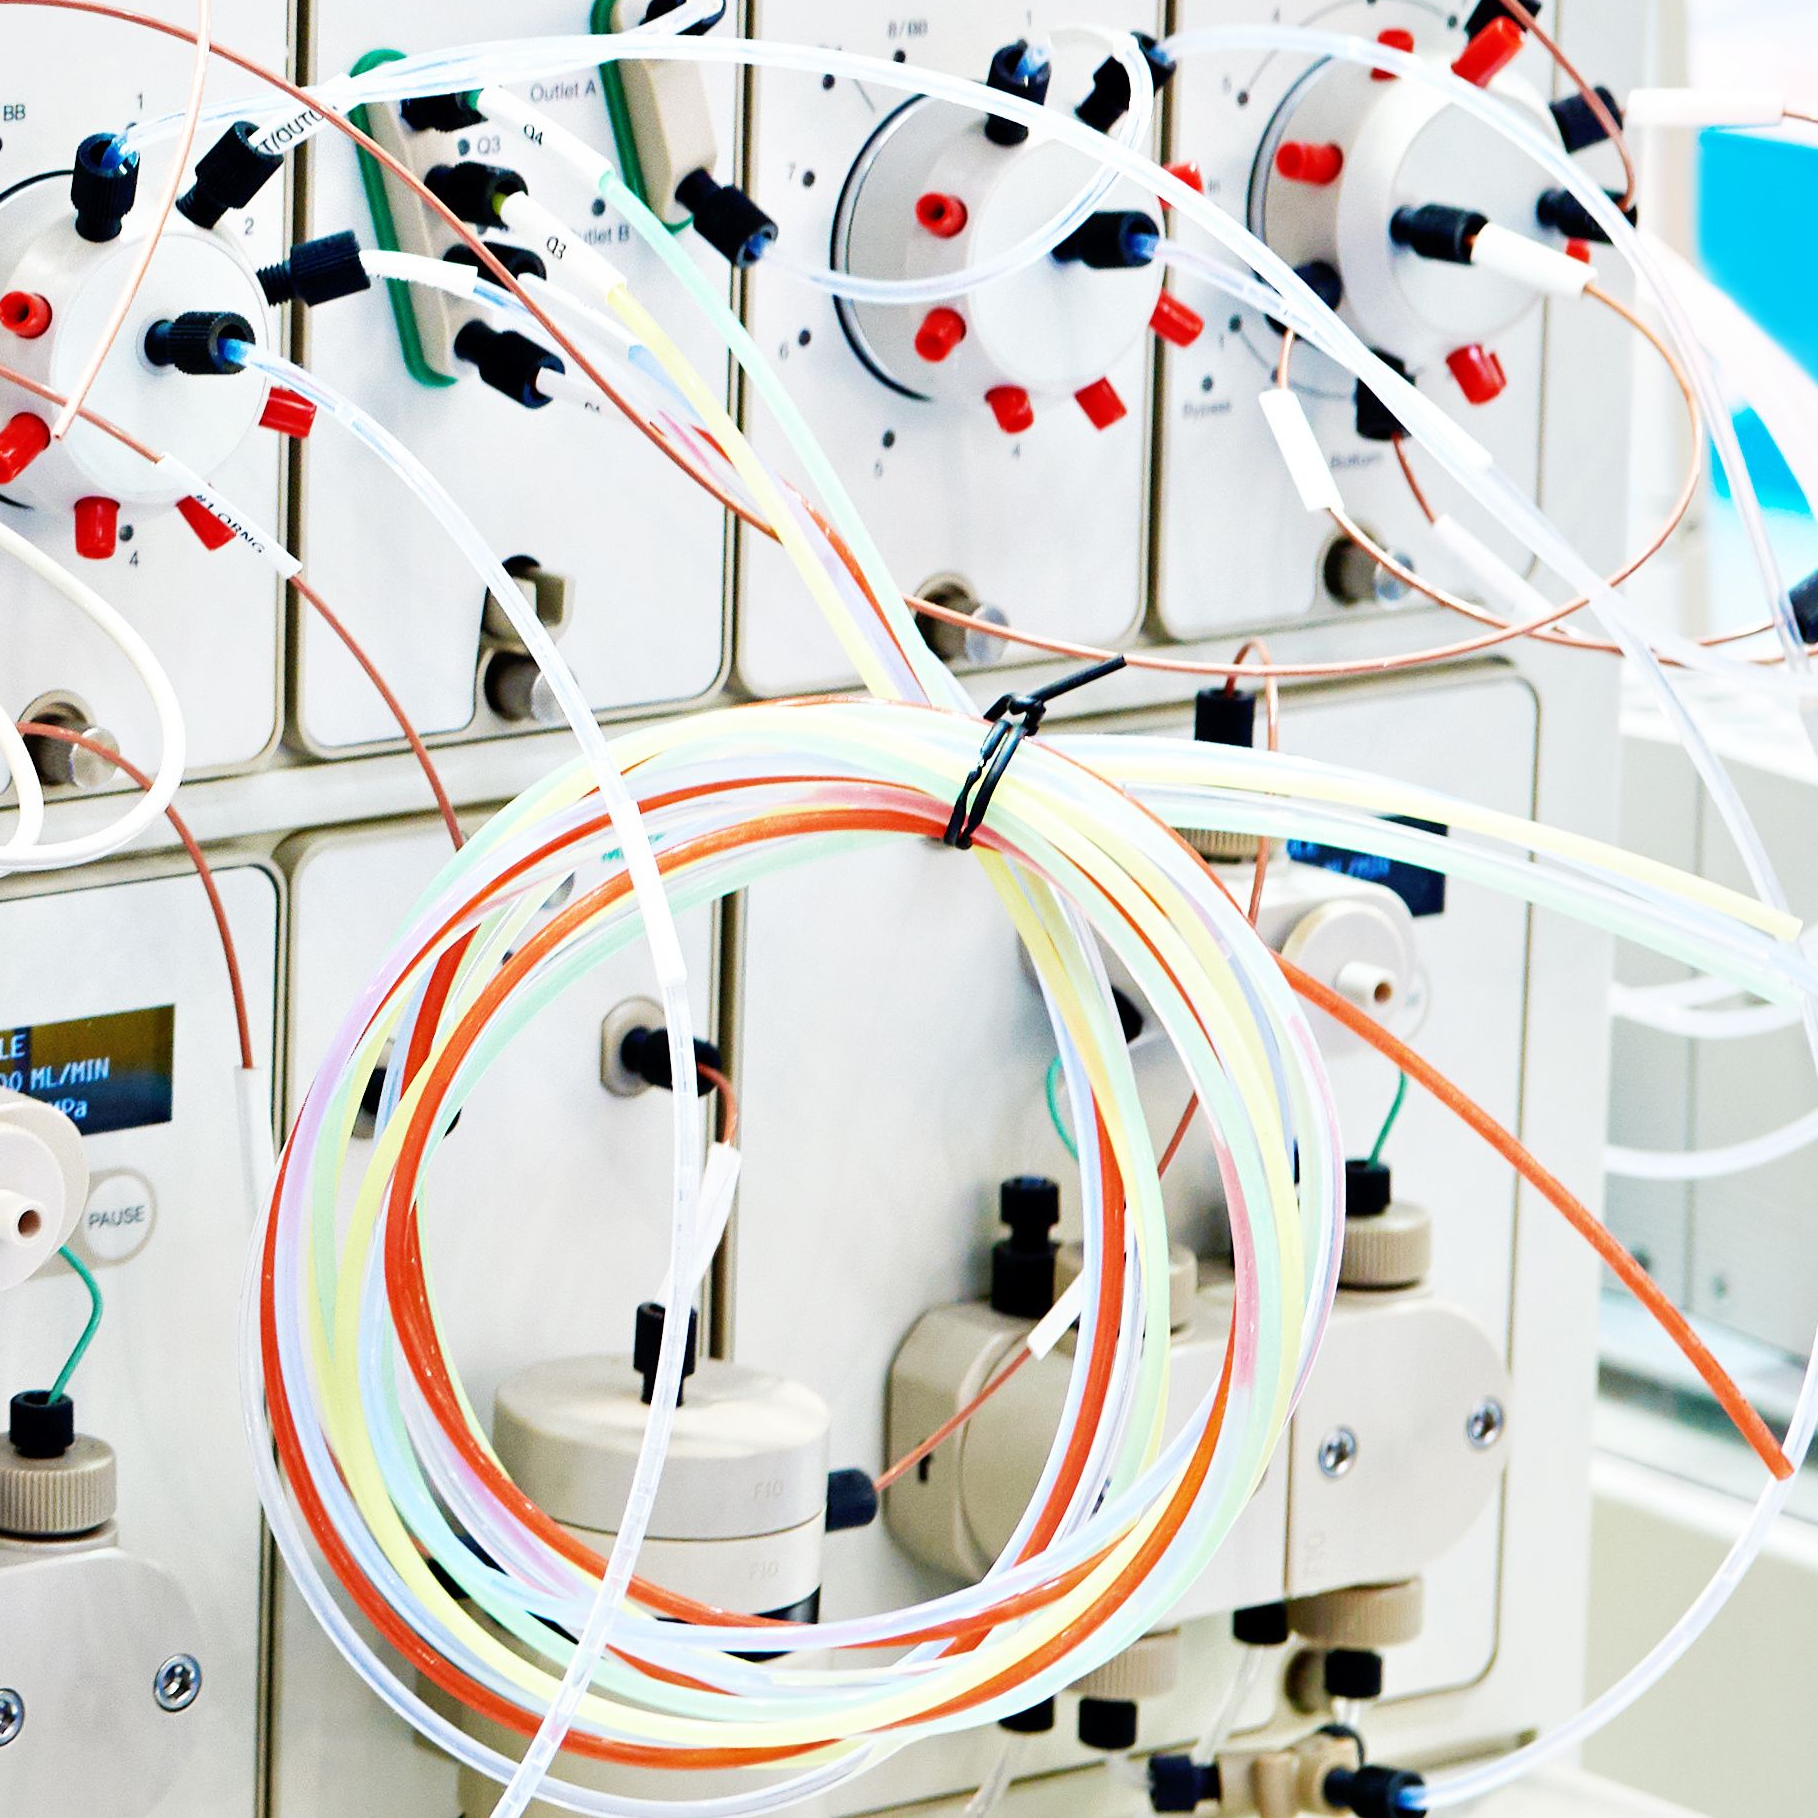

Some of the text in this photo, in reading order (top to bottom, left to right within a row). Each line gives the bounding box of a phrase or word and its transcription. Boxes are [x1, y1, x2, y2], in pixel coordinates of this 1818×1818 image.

[530, 80, 597, 102] Outlet A
[477, 136, 501, 155] Q3
[523, 123, 543, 146] Q4
[244, 218, 254, 235] 2
[572, 228, 612, 244] utlet
[546, 235, 567, 260] Q3
[129, 549, 139, 566] 4
[30, 1057, 111, 1090] ML/MIN
[87, 1205, 146, 1227] PAUSE
